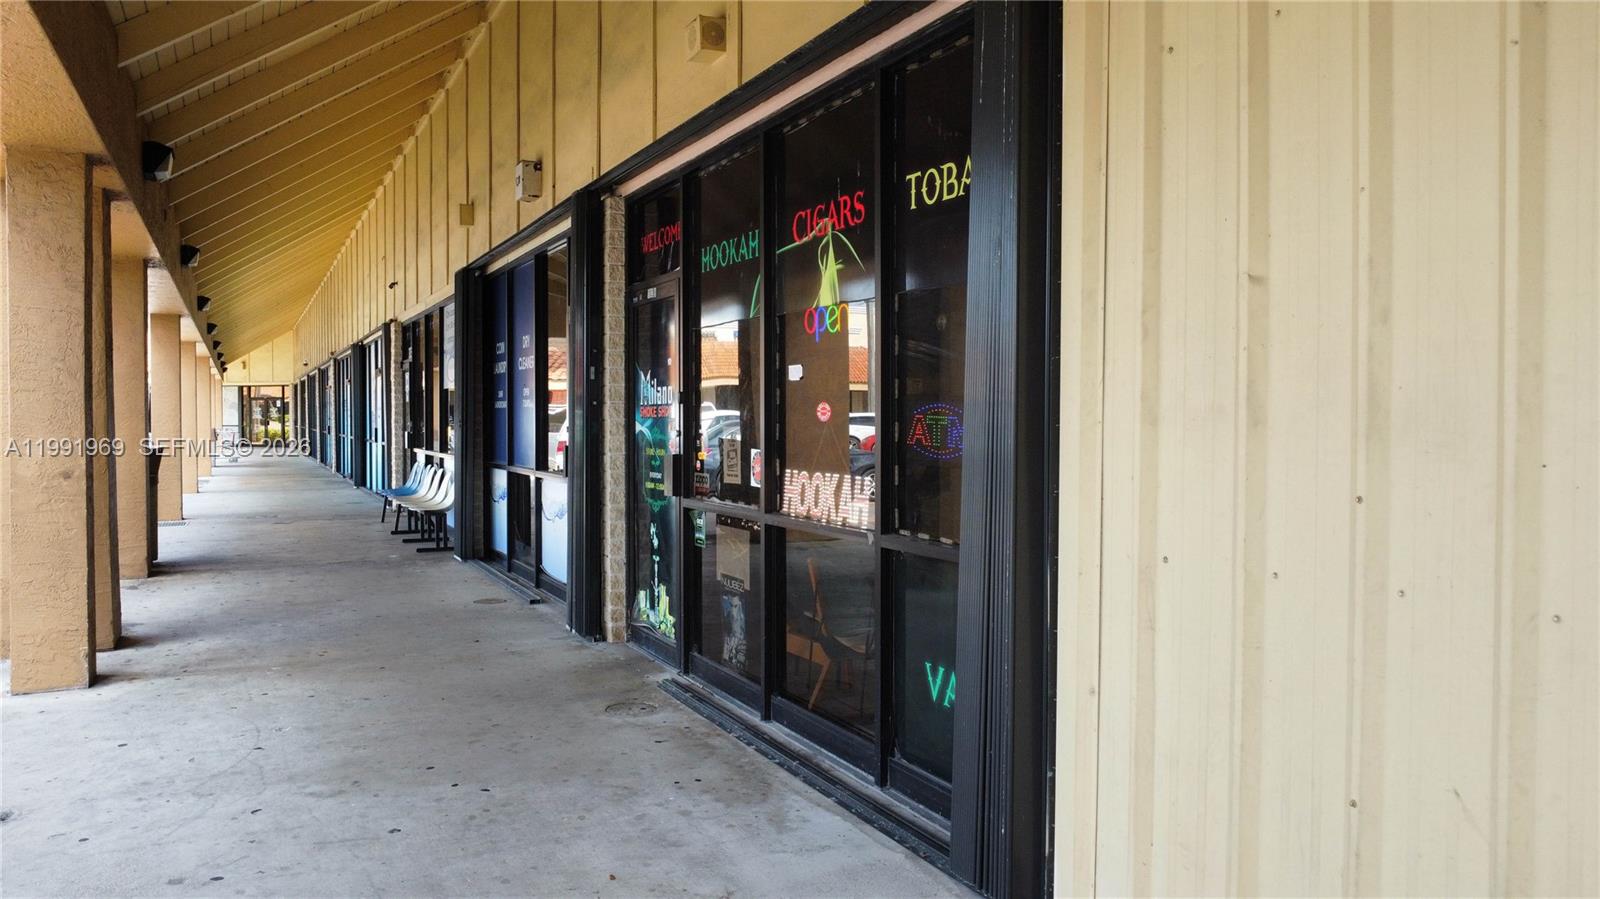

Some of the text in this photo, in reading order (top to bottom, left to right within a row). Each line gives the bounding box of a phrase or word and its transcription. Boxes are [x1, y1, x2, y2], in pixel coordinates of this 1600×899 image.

[792, 191, 866, 244] CIGARS
[701, 229, 760, 273] HOOKAH
[804, 303, 849, 344] open
[640, 369, 672, 405] Milano
[640, 406, 657, 417] SMOKE
[782, 469, 872, 528] HOOKAH
